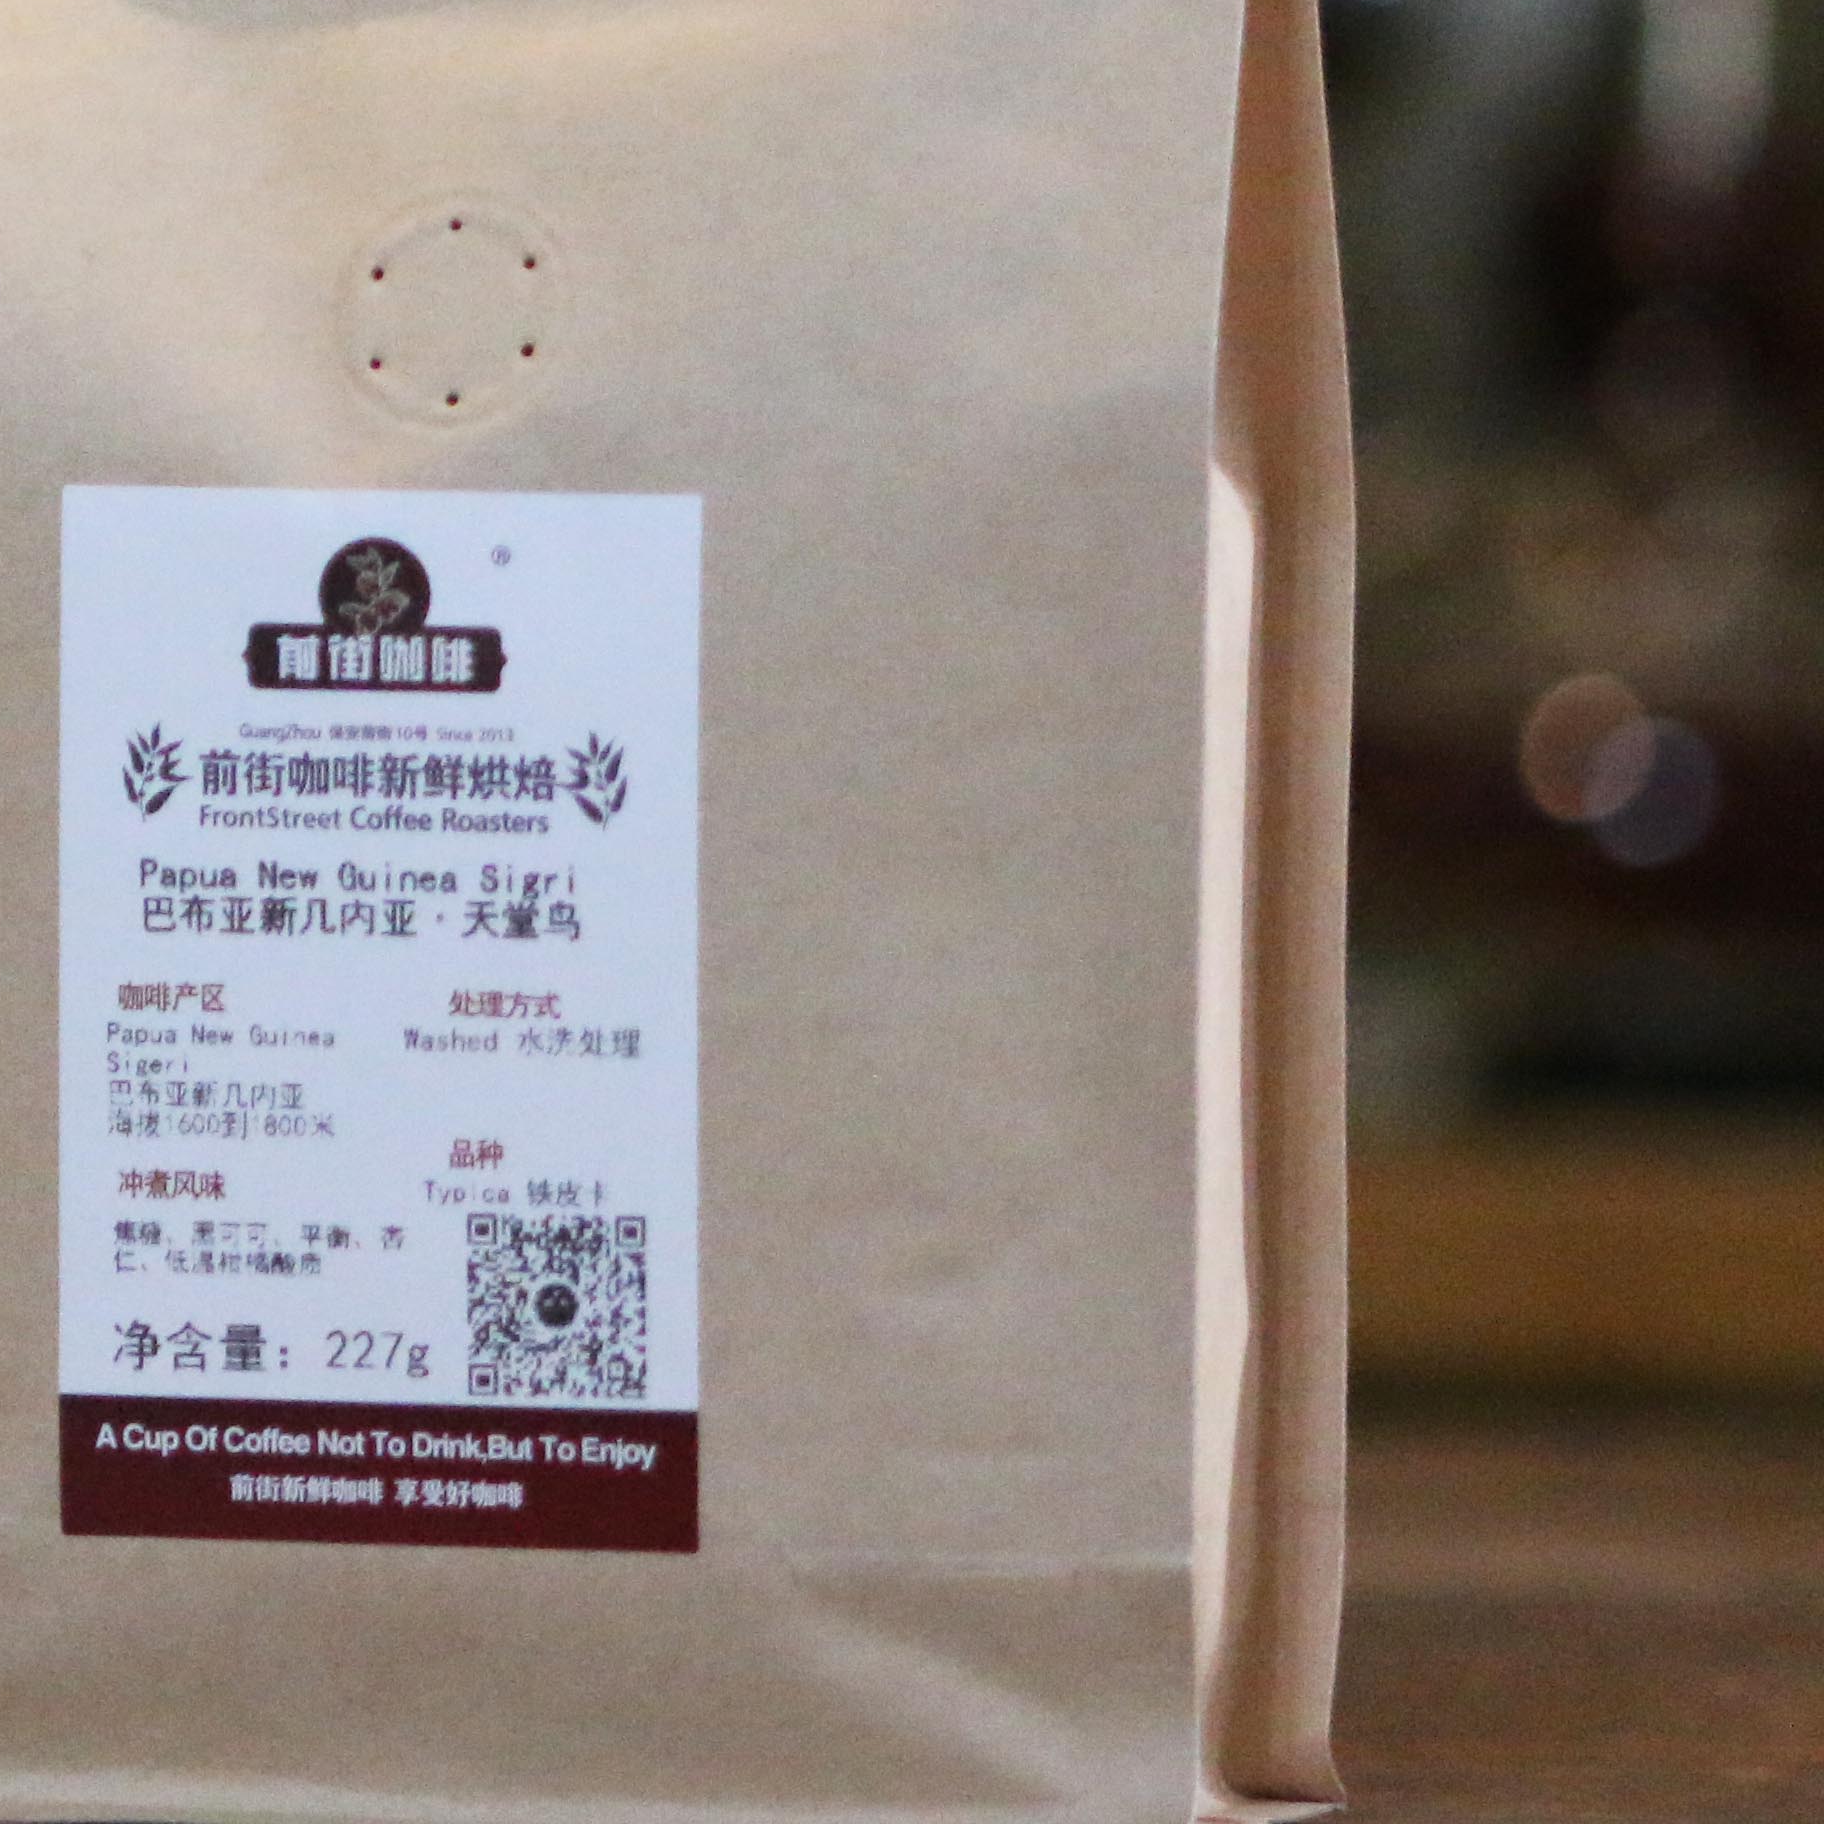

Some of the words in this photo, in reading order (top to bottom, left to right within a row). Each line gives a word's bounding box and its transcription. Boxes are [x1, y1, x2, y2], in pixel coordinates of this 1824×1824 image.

[277, 633, 473, 683] 前街咖啡
[199, 748, 555, 802] 前街咖啡新鲜烘焙
[199, 804, 341, 830] FrontStreet
[352, 804, 432, 832] Coffee
[442, 807, 549, 835] Roasters
[140, 858, 238, 900] Papua
[258, 860, 319, 891] New
[338, 861, 457, 894] Guinea
[480, 863, 575, 900] Sigri
[118, 981, 224, 1012] 咖啡产区
[449, 989, 561, 1019] 处理方式
[107, 1022, 177, 1046] Papua
[191, 1024, 234, 1045] New
[250, 1024, 335, 1047] Guinea
[403, 1028, 498, 1052] Washed
[518, 1027, 640, 1058] 水洗处理
[110, 1079, 303, 1109] 巴布亚新几内亚
[449, 1138, 504, 1170] 品种
[119, 1168, 225, 1201] 冲煮风味
[95, 1422, 118, 1450] A
[123, 1422, 179, 1458] Cup
[185, 1424, 219, 1452] Of
[223, 1425, 311, 1456] Coffee
[317, 1428, 365, 1457] Not
[370, 1429, 407, 1458] To
[539, 1435, 577, 1463] To
[581, 1436, 656, 1471] Enjoy
[230, 1473, 384, 1505] 前街新鲜咖啡
[394, 1477, 525, 1509] 享受好咖啡
